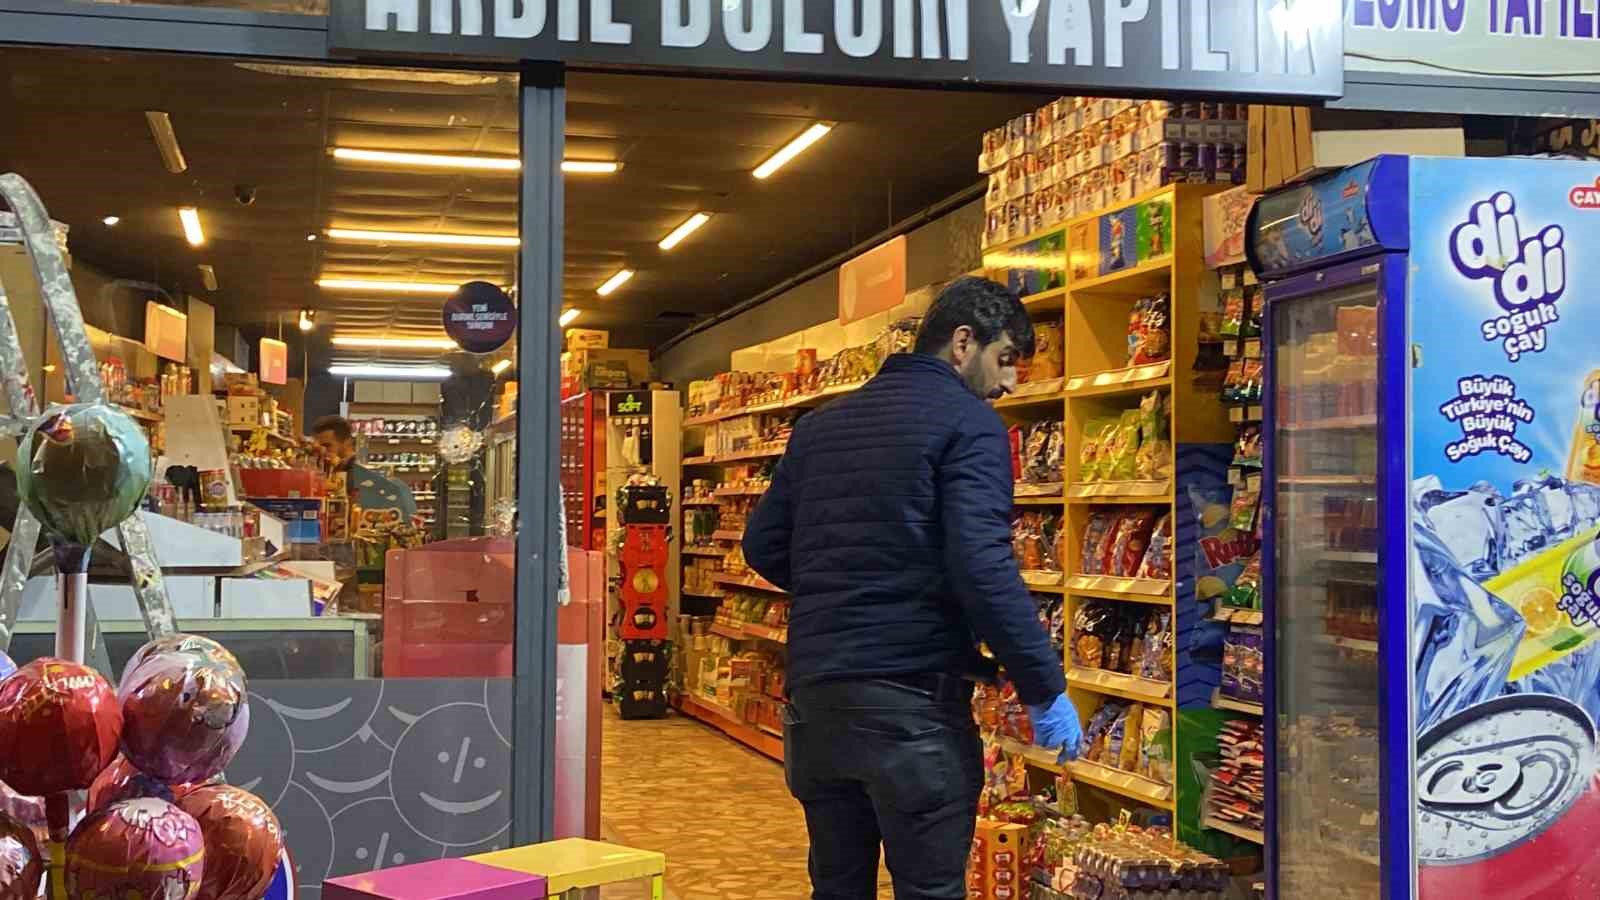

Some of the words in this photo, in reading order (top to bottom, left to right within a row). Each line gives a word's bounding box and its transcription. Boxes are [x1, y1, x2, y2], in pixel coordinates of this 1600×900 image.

[1483, 302, 1557, 339] soğuk
[1504, 328, 1545, 361] çay
[1459, 377, 1514, 397] Büyük
[1462, 416, 1515, 433] Büyük
[1446, 433, 1497, 460] Soğuk
[1499, 435, 1531, 461] Çayı
